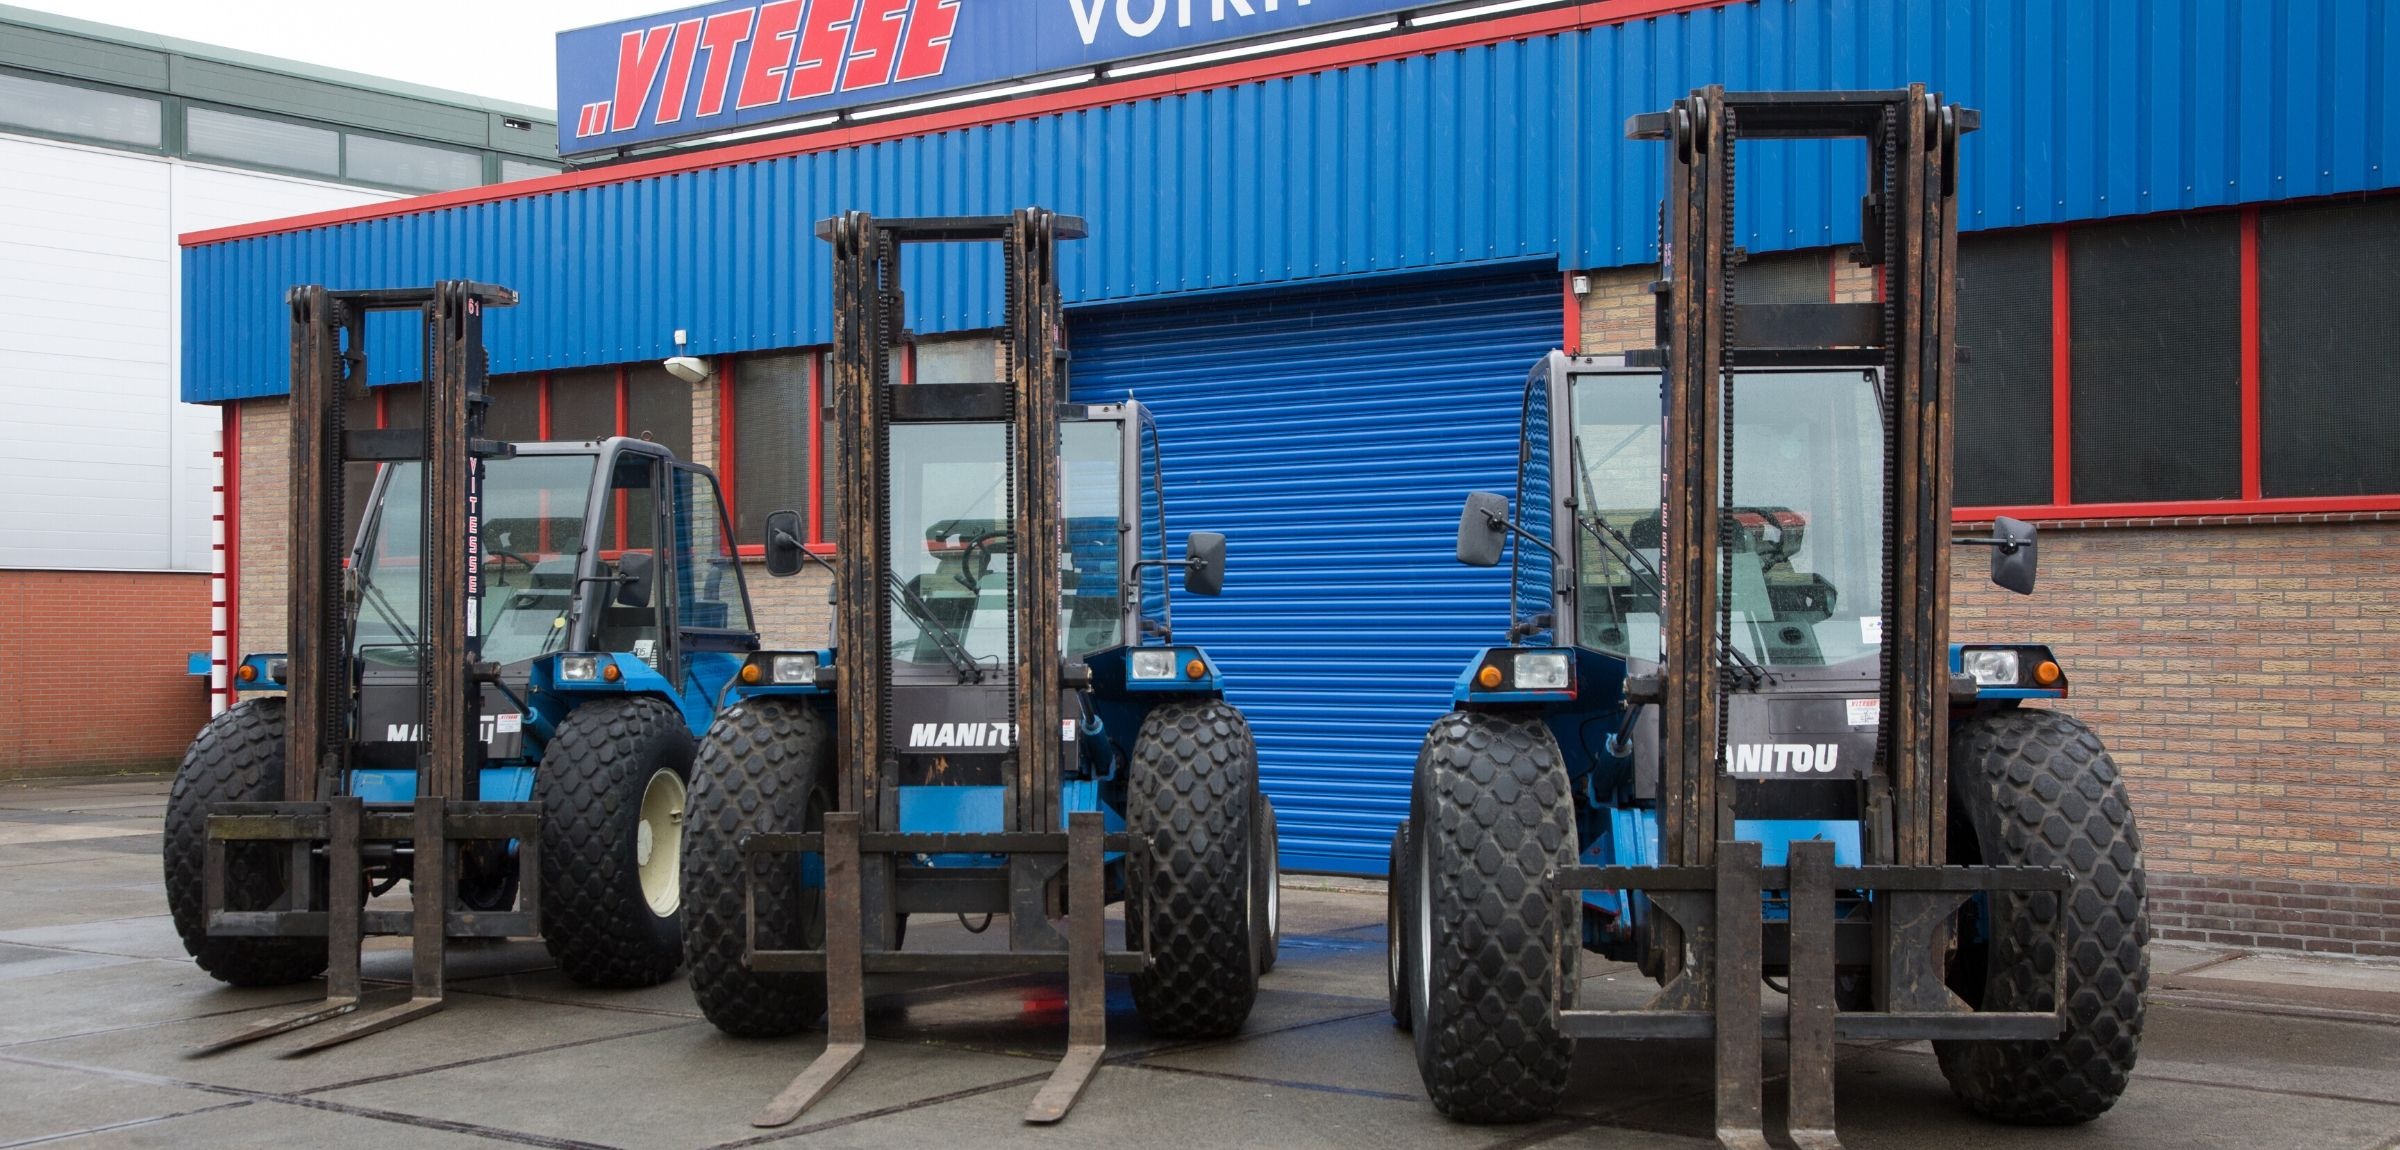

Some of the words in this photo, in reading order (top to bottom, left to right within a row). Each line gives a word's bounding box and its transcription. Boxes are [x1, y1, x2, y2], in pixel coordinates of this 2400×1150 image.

[468, 298, 479, 317] 61
[469, 457, 477, 593] VITESSE
[909, 722, 1020, 748] MANITO
[1715, 743, 1838, 773] ANITOU
